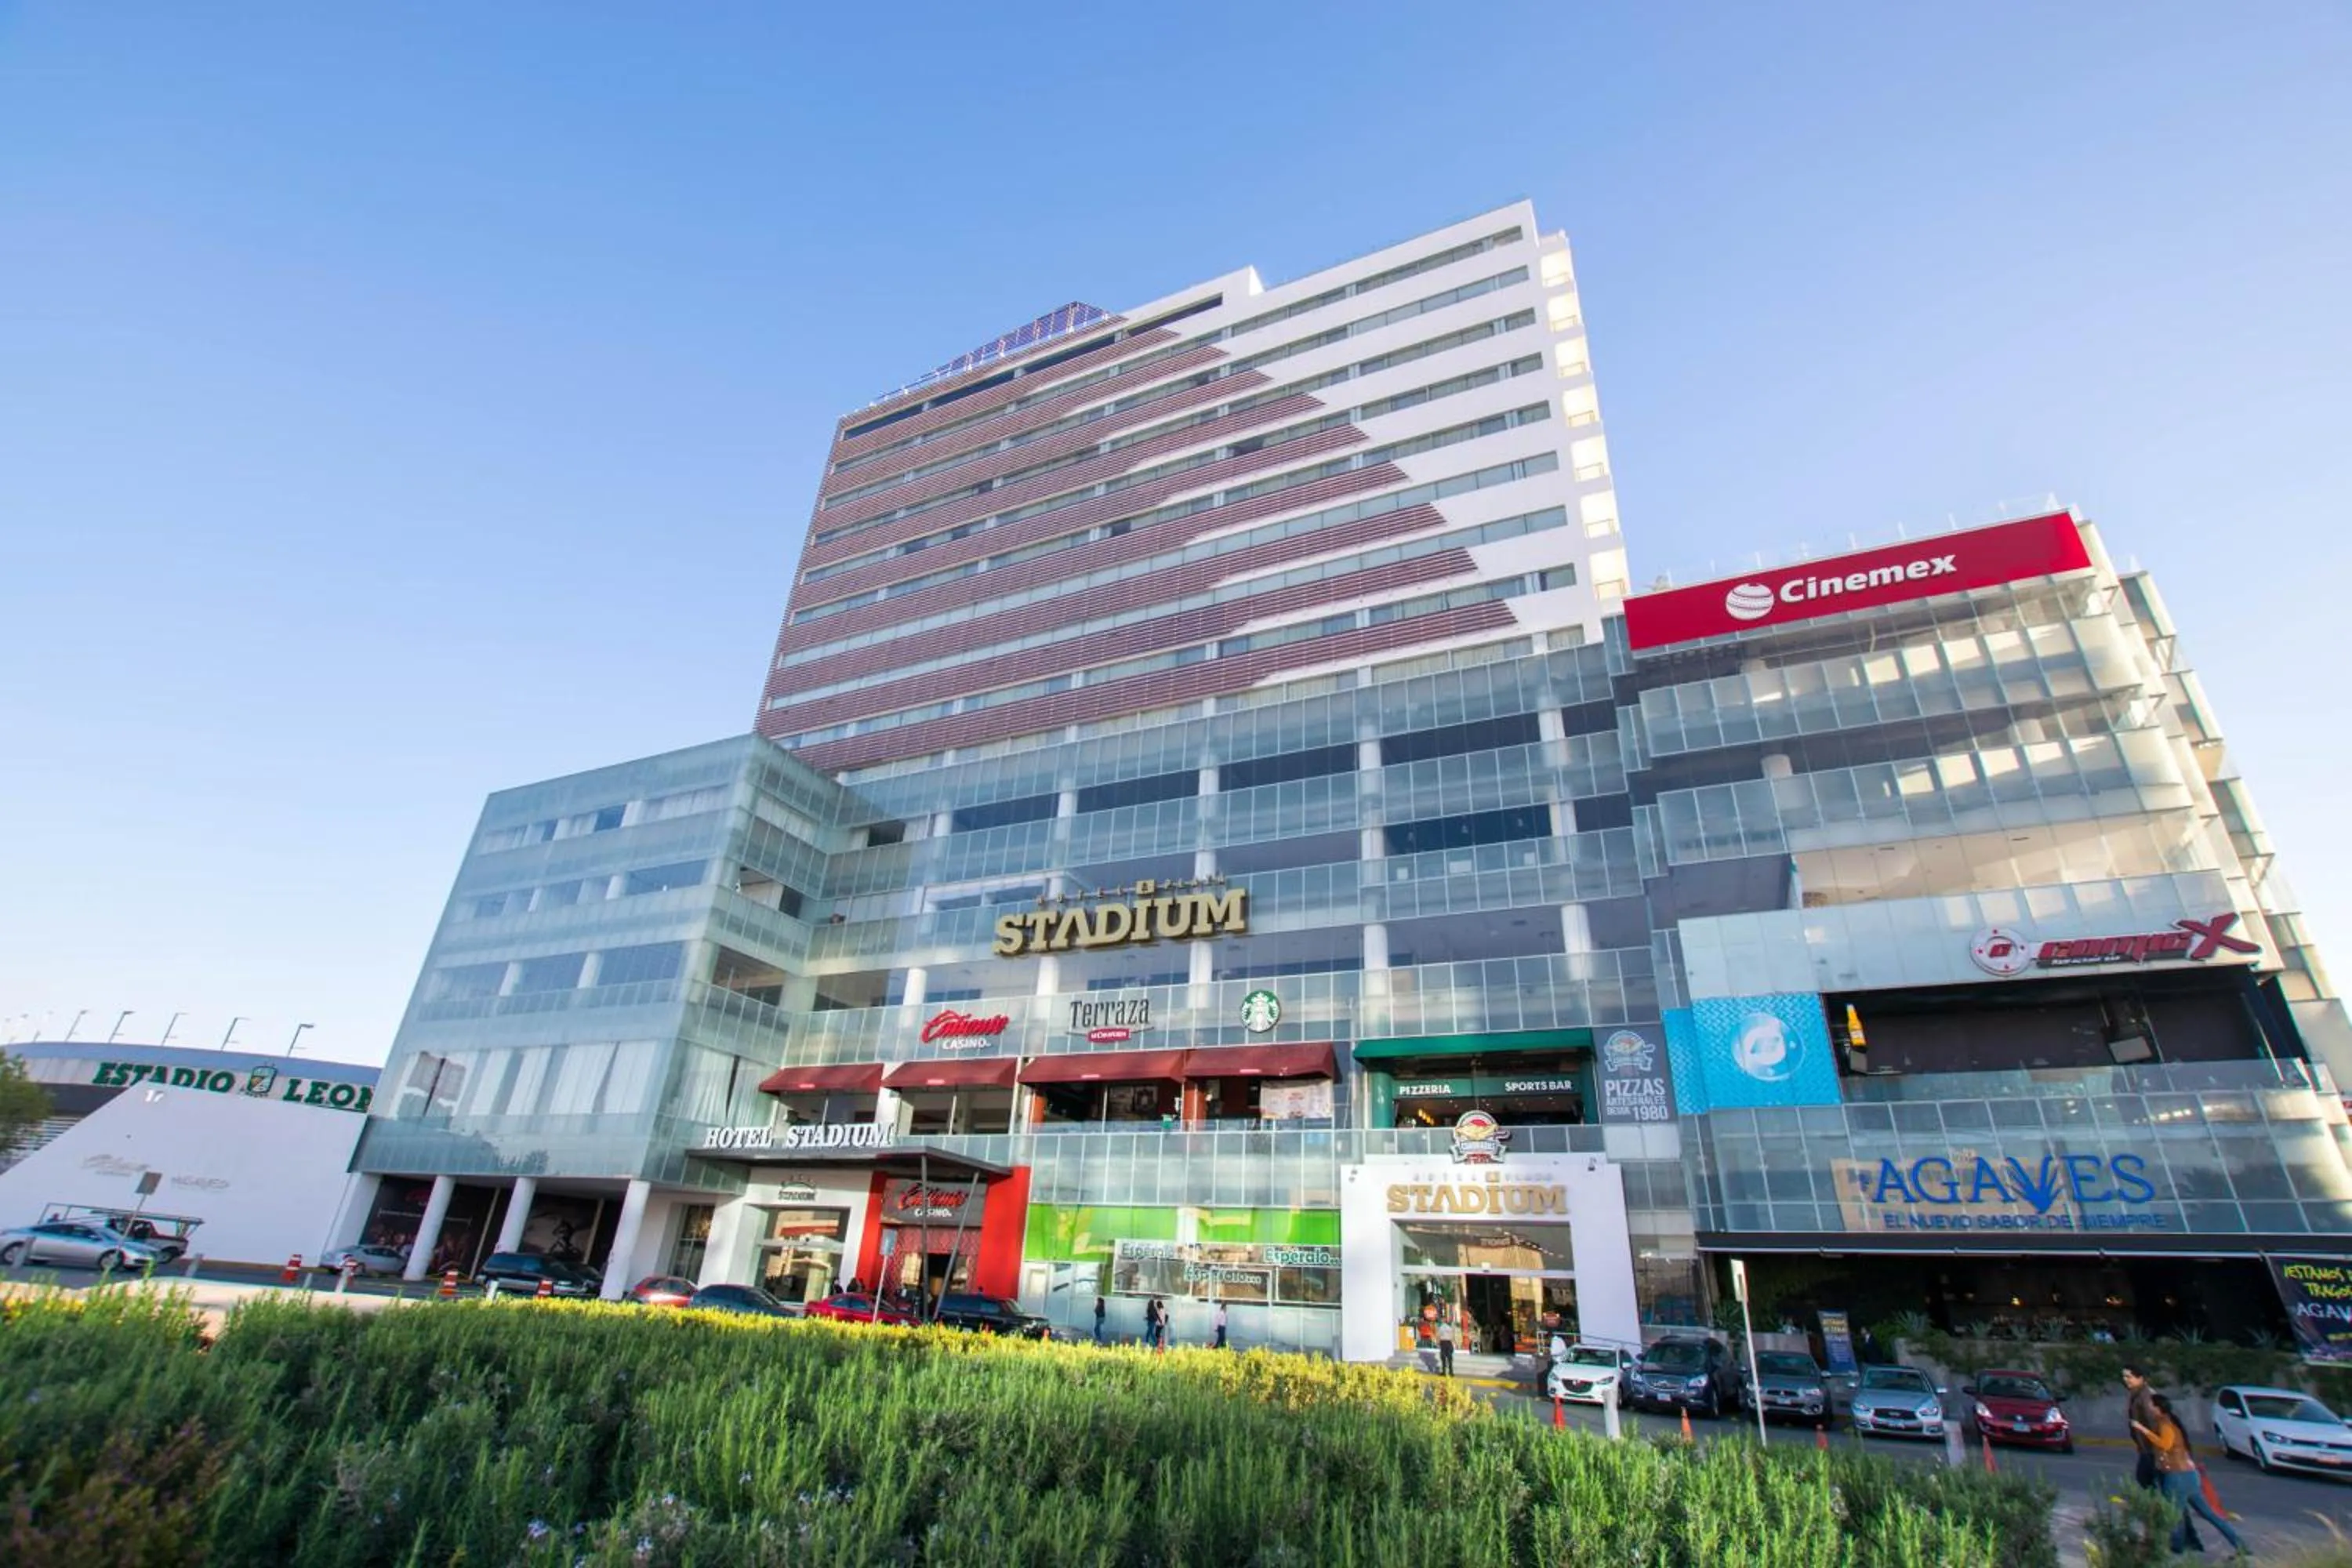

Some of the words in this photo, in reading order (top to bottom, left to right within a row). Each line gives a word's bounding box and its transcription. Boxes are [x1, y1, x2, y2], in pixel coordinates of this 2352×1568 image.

[1780, 553, 1958, 604] Cinemex
[993, 888, 1247, 956] STADIUM
[922, 1009, 1011, 1043] Caliente
[1069, 998, 1150, 1029] Terraza
[942, 1036, 988, 1050] CASINO
[92, 1062, 235, 1094] ESTADIO
[1399, 1084, 1451, 1095] PIZZERIA
[1504, 1080, 1547, 1091] SPORTS
[1549, 1080, 1572, 1090] BAR
[1605, 1078, 1666, 1096] PIZZAS
[1632, 1105, 1668, 1121] 1980
[703, 1126, 773, 1148] HOTEL
[785, 1123, 895, 1149] STADIUM
[898, 1182, 969, 1210] Caiente
[1872, 1154, 2155, 1214] AGAVES
[914, 1208, 950, 1217] CSINO
[1386, 1184, 1569, 1214] STADIUM
[1884, 1214, 1906, 1229] EL
[1909, 1214, 1971, 1229] NUEVO
[1977, 1214, 2041, 1229] SABOR
[2047, 1214, 2072, 1229] DE
